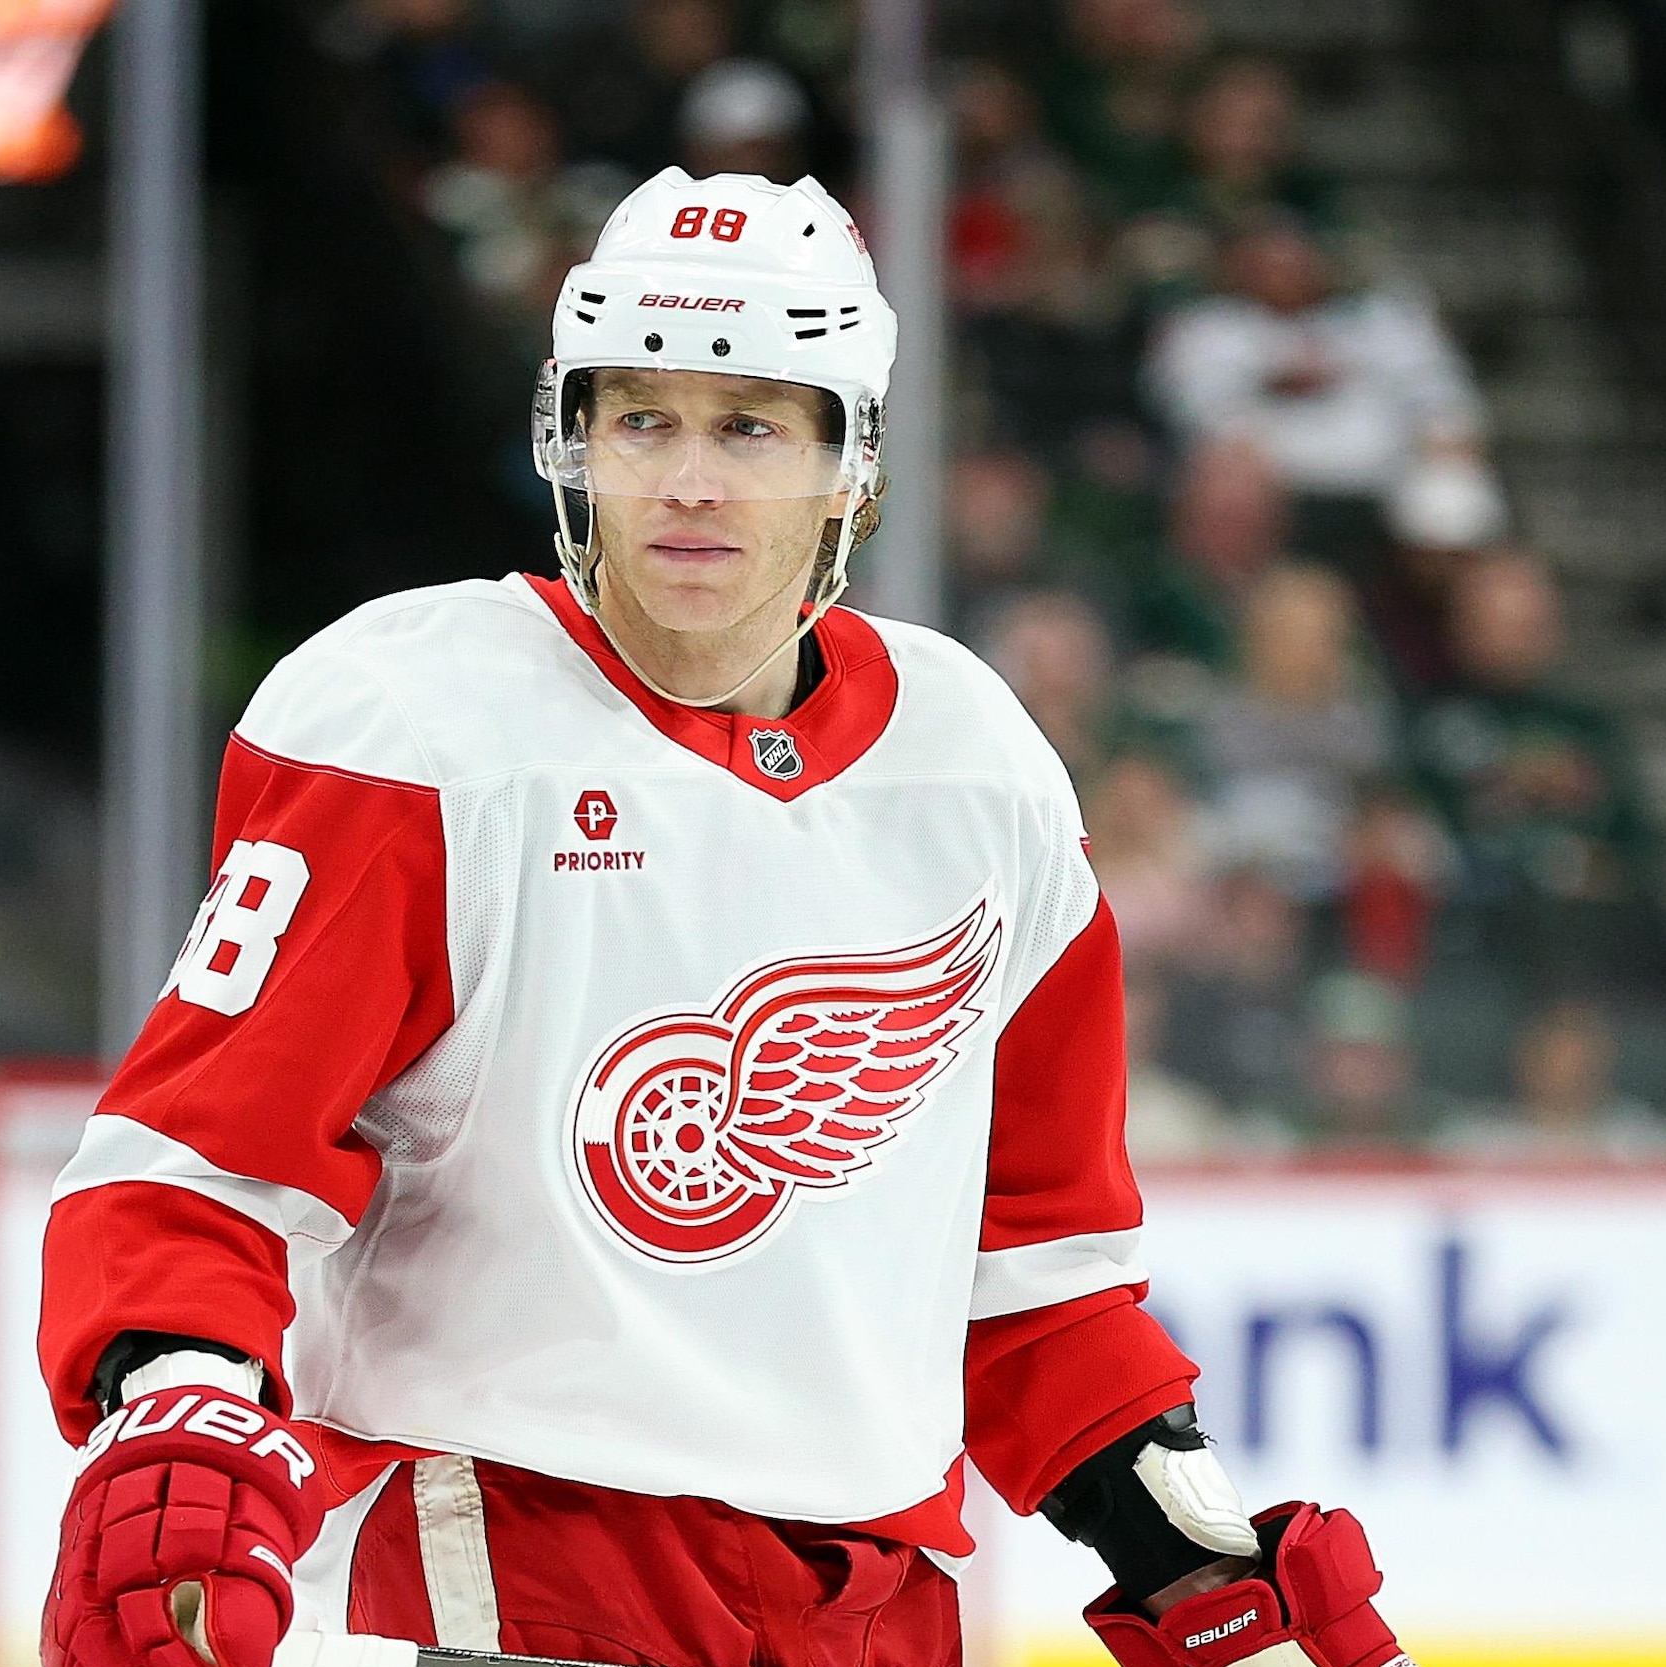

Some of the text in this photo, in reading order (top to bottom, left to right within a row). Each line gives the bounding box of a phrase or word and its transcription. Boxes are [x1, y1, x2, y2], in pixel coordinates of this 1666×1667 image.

[670, 206, 748, 243] 88
[637, 293, 746, 313] BAUER
[763, 743, 789, 770] NHL
[553, 851, 646, 871] PRIORITY
[1185, 1608, 1258, 1649] BAUER
